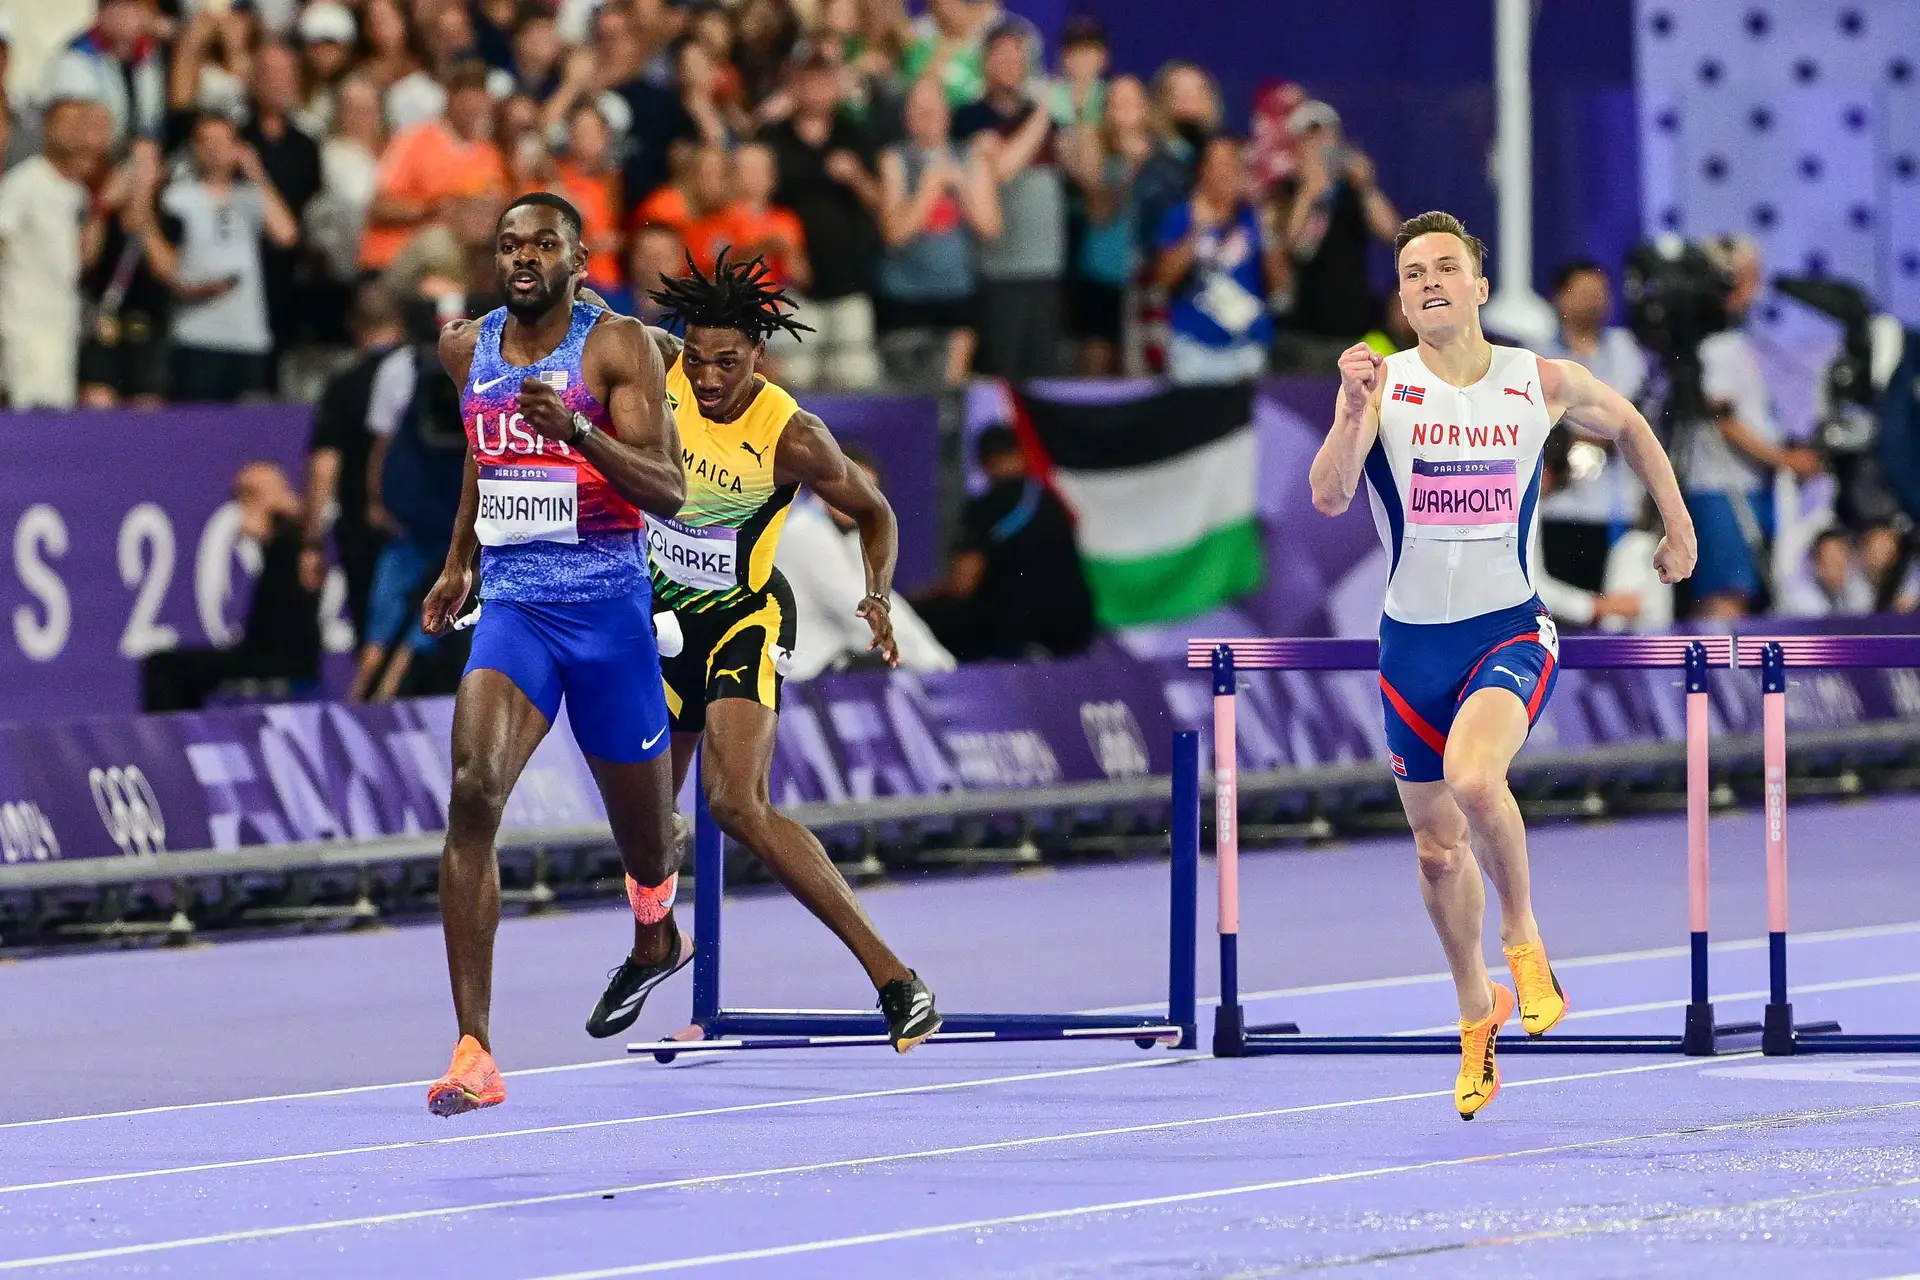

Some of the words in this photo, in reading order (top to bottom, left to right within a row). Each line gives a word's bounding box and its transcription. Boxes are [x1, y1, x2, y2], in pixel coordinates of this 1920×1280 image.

[1411, 423, 1519, 448] NORWAY
[521, 469, 548, 479] 2024
[681, 447, 742, 494] MAICA
[1433, 464, 1462, 473] PARIS
[1464, 464, 1491, 472] 2024
[481, 494, 573, 522] BENJAMIN
[1411, 487, 1513, 513] WARHOLM
[650, 529, 731, 574] CLARKE
[1481, 1023, 1498, 1087] NITRO
